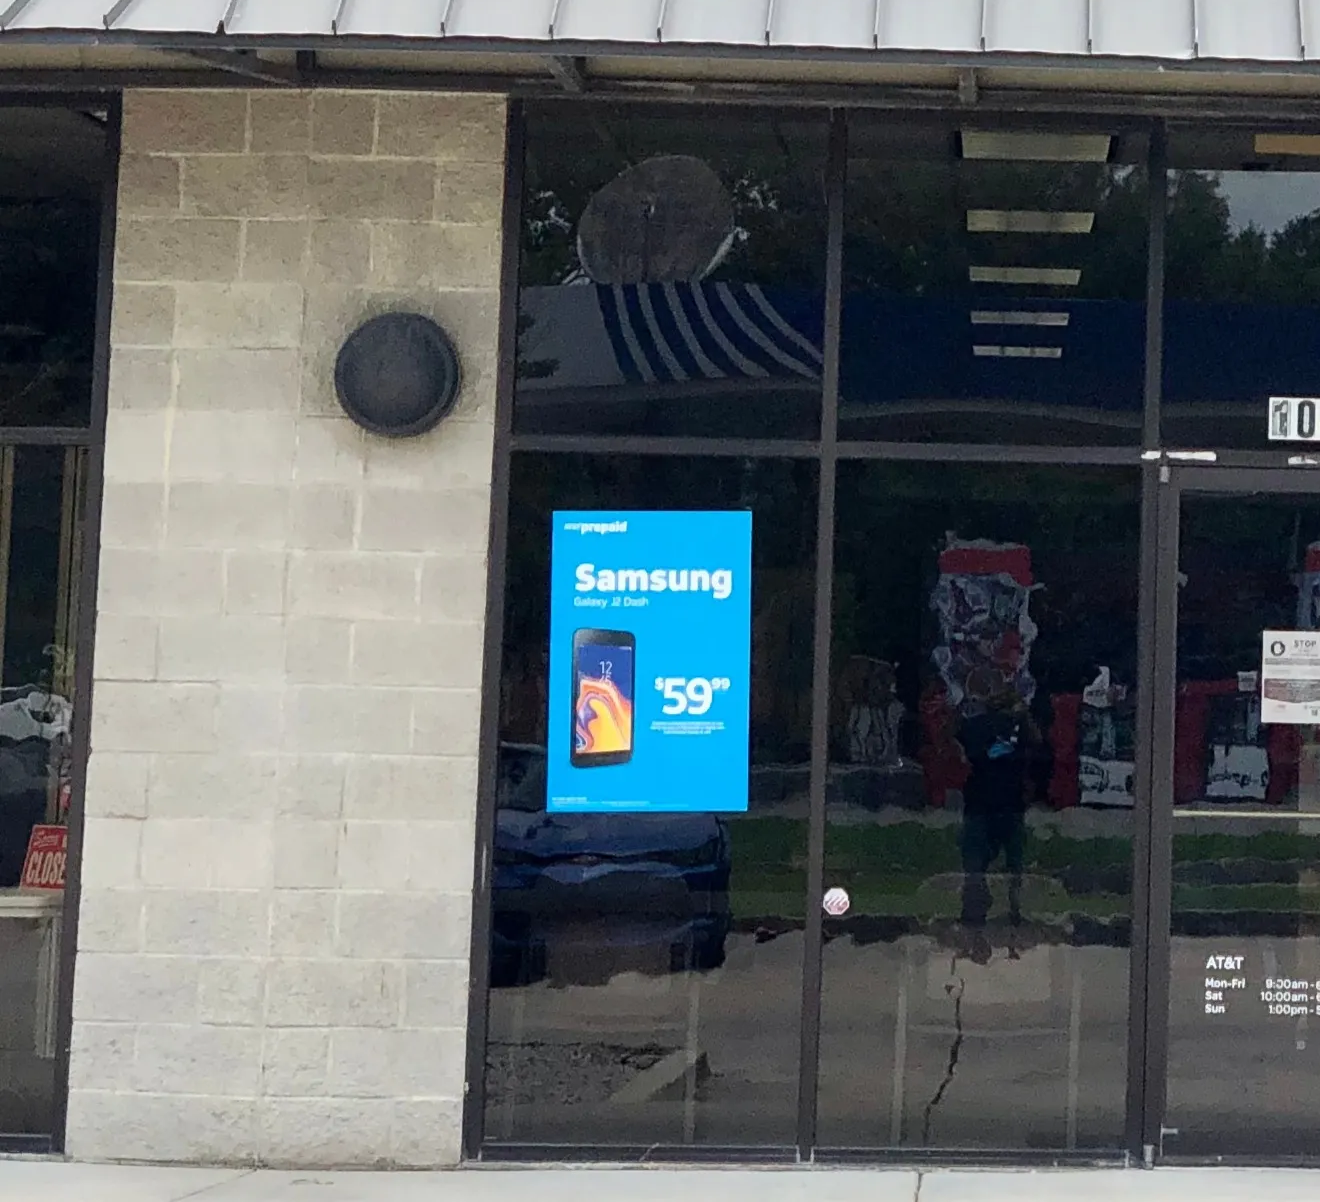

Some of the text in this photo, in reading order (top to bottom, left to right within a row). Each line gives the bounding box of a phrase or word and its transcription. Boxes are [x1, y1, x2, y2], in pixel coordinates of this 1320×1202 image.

[574, 563, 733, 600] Samsung
[573, 596, 608, 609] Galaxy
[623, 596, 649, 607] Dash
[1294, 640, 1317, 648] STOP
[599, 661, 613, 674] 12
[1206, 955, 1244, 970] AT&T
[1205, 977, 1246, 989] Mon-Fri
[1205, 990, 1223, 1001] Sat
[1260, 991, 1308, 1002] 10:00am
[1205, 1003, 1226, 1014] Sun
[1268, 1004, 1308, 1016] 1:00pm
